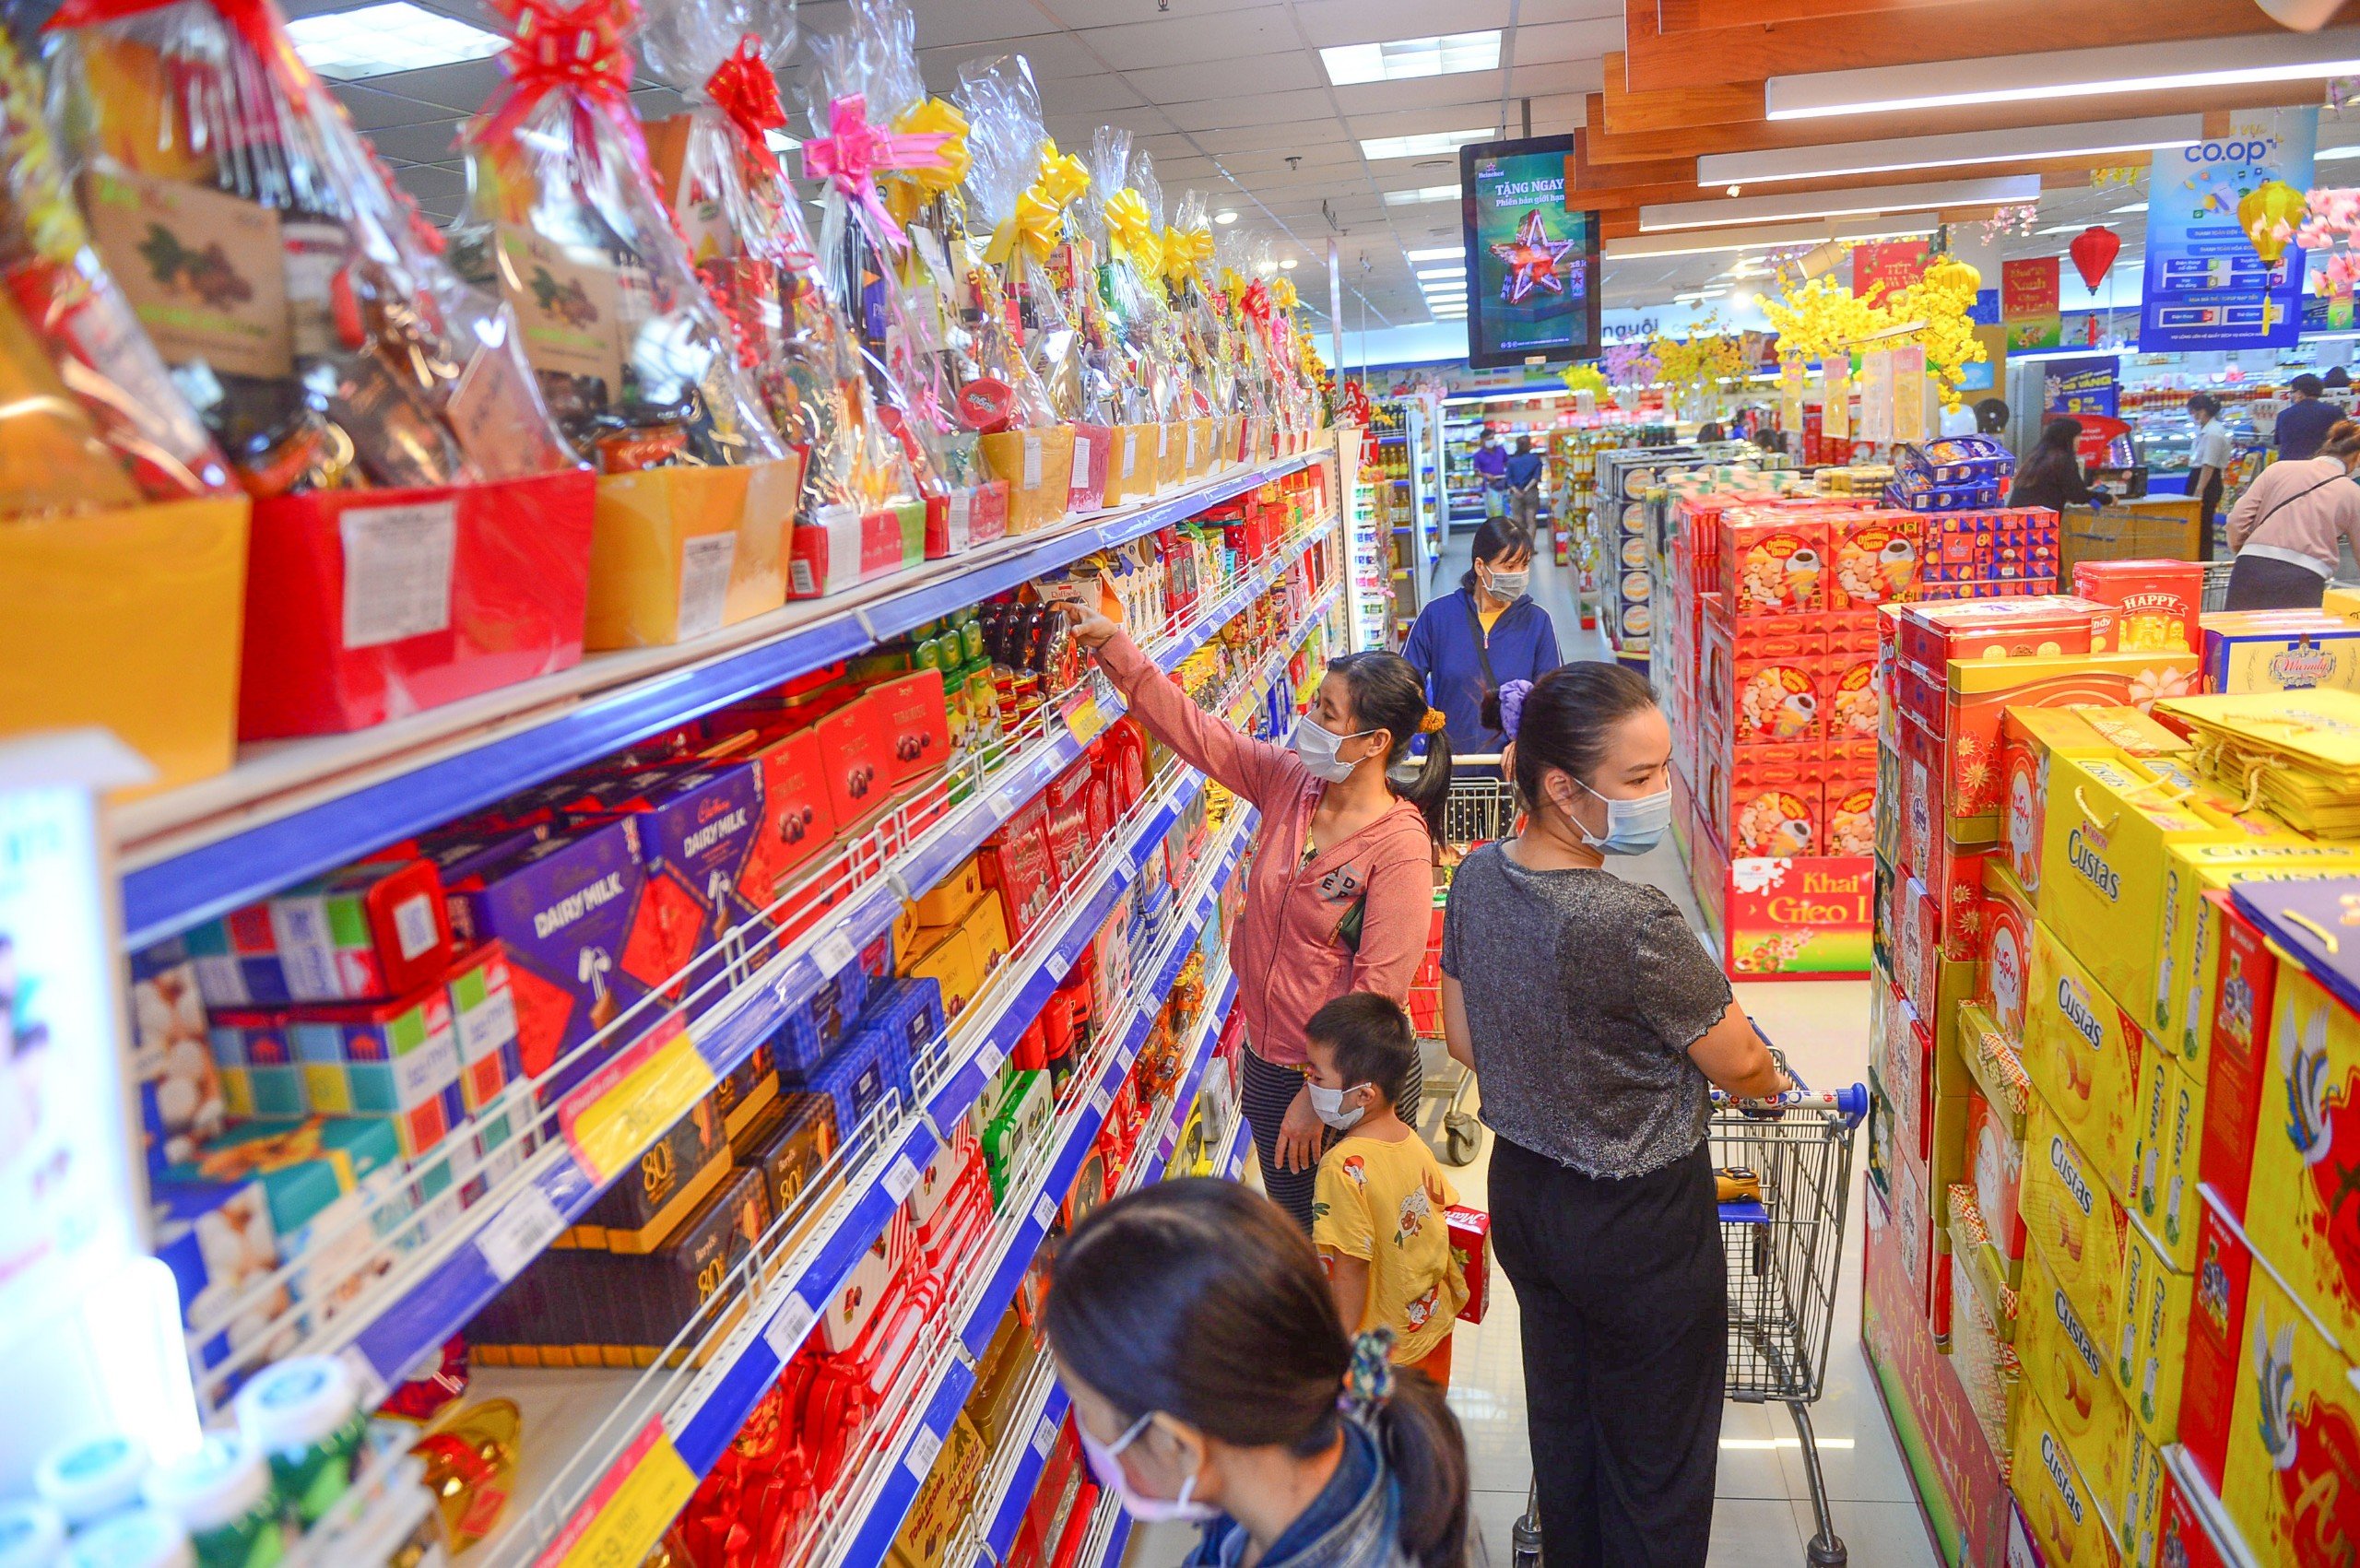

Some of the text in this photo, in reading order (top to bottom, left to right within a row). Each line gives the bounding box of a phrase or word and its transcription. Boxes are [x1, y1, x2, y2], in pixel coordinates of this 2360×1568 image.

[1478, 171, 1504, 179] Heineken
[1495, 178, 1564, 198] TẶNG NGAY
[1496, 194, 1565, 206] Phiên bản giới hạn
[968, 394, 996, 413] sugus
[2123, 595, 2178, 609] HAPPY
[683, 807, 749, 859] DAIRY MILK
[2201, 845, 2354, 857] Custas
[1802, 871, 1858, 894] Khai
[2068, 828, 2121, 903] Custas
[534, 889, 584, 939] DAIRY
[583, 870, 626, 913] MILK
[1767, 895, 1847, 924] Gieo
[2058, 975, 2104, 1051] Custas
[2150, 1064, 2165, 1141] Custas
[2175, 1089, 2190, 1167] Custas
[642, 1141, 668, 1192] 80
[2051, 1135, 2094, 1218] Custas
[2055, 1288, 2100, 1379] Custas
[2150, 1275, 2166, 1353] Custas
[2041, 1430, 2083, 1527] Custas
[908, 1472, 946, 1550] TOBLERONE
